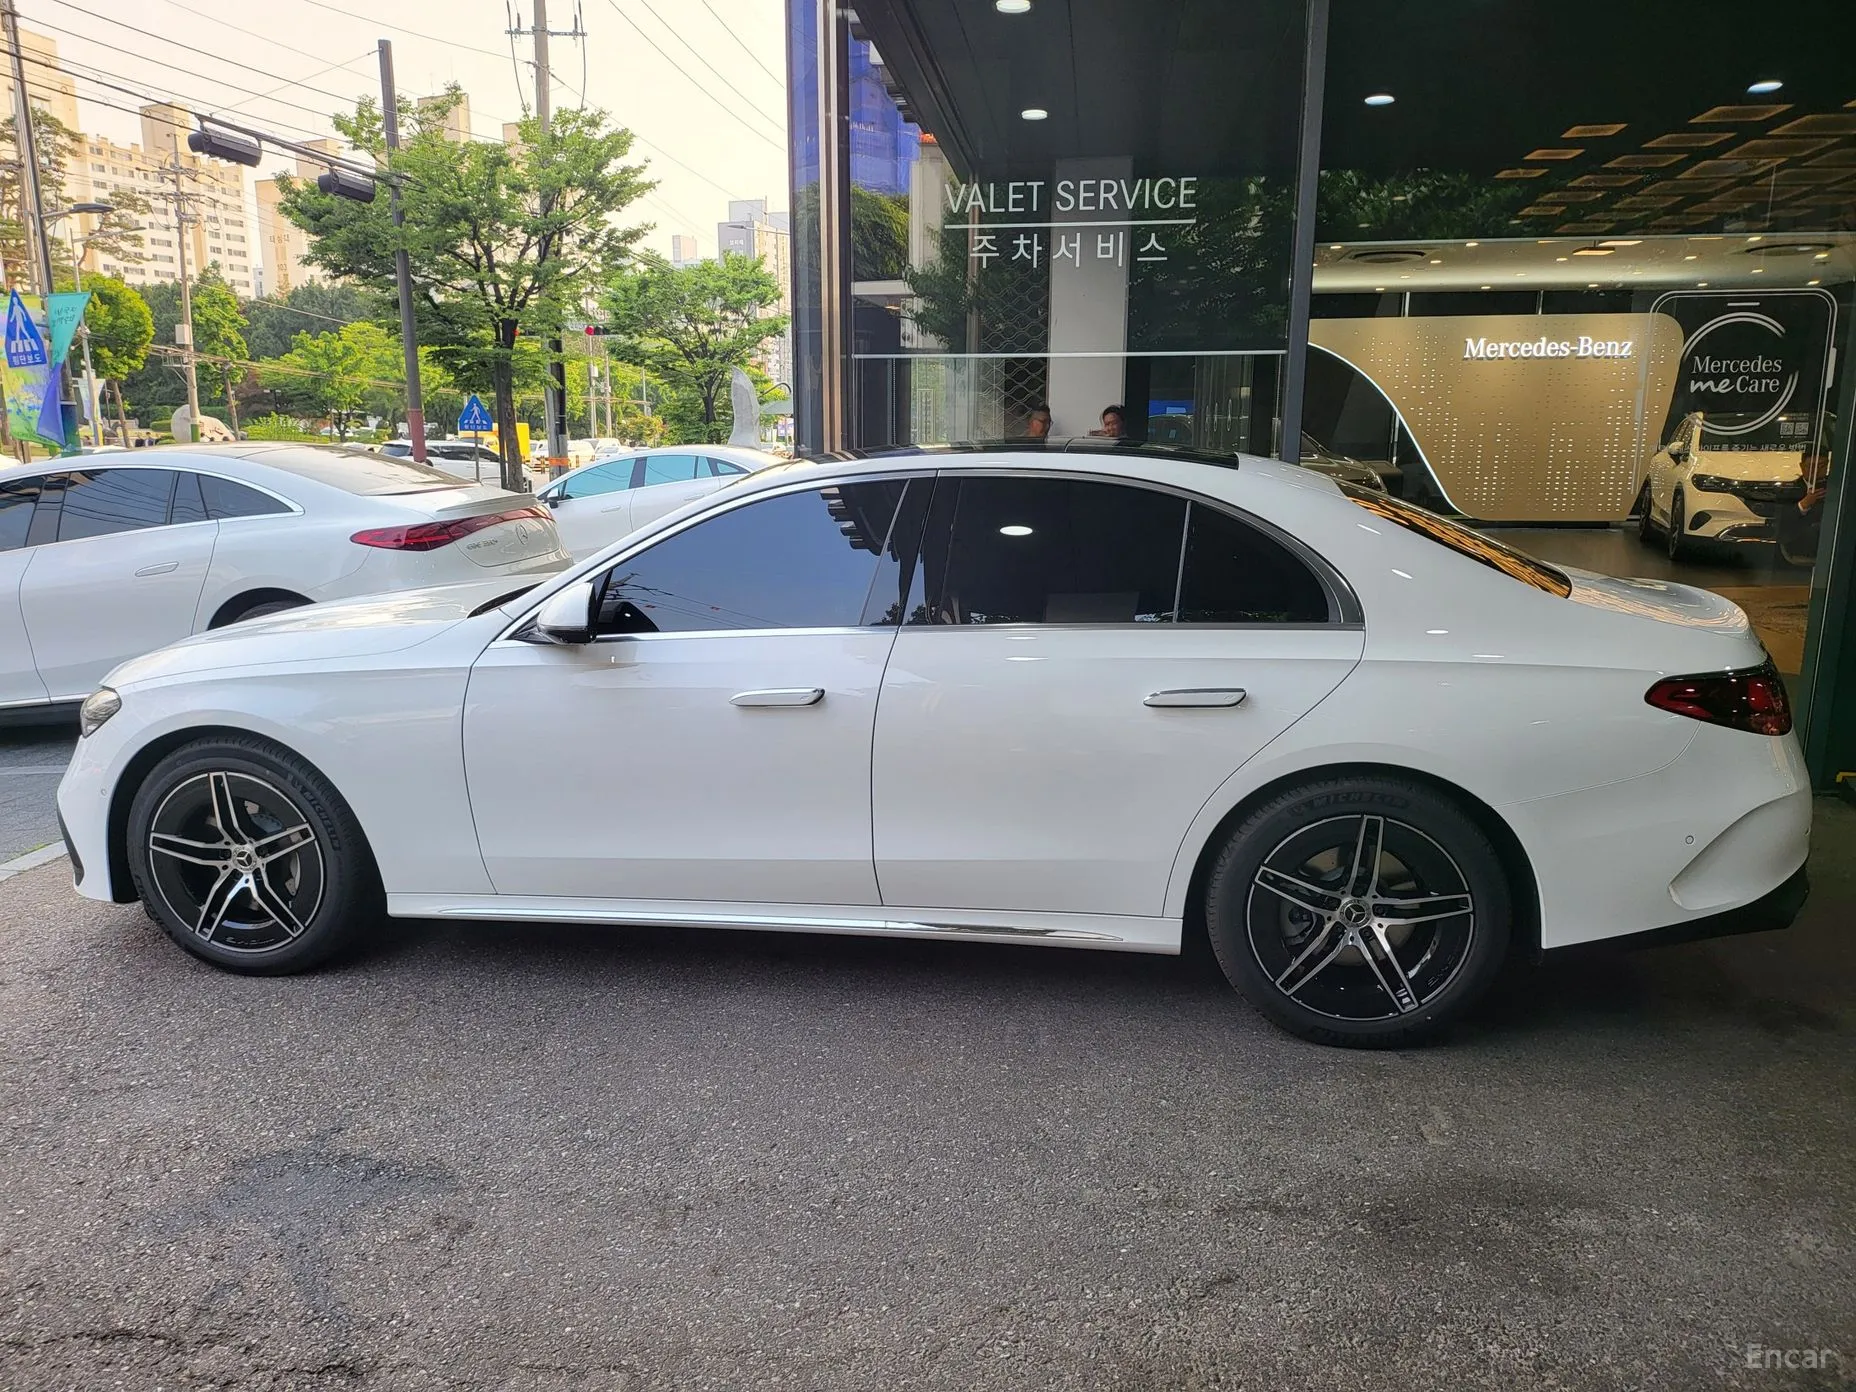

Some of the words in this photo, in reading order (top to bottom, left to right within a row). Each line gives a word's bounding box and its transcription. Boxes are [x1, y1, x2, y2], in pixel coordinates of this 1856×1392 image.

[945, 180, 1045, 213] VALET
[1055, 176, 1198, 211] SERVICE
[970, 231, 1168, 268] 주차서비스
[1463, 336, 1633, 359] Mercedes-Benz
[1692, 355, 1782, 374] Mercedes
[1690, 378, 1735, 394] me
[1736, 375, 1780, 393] Care
